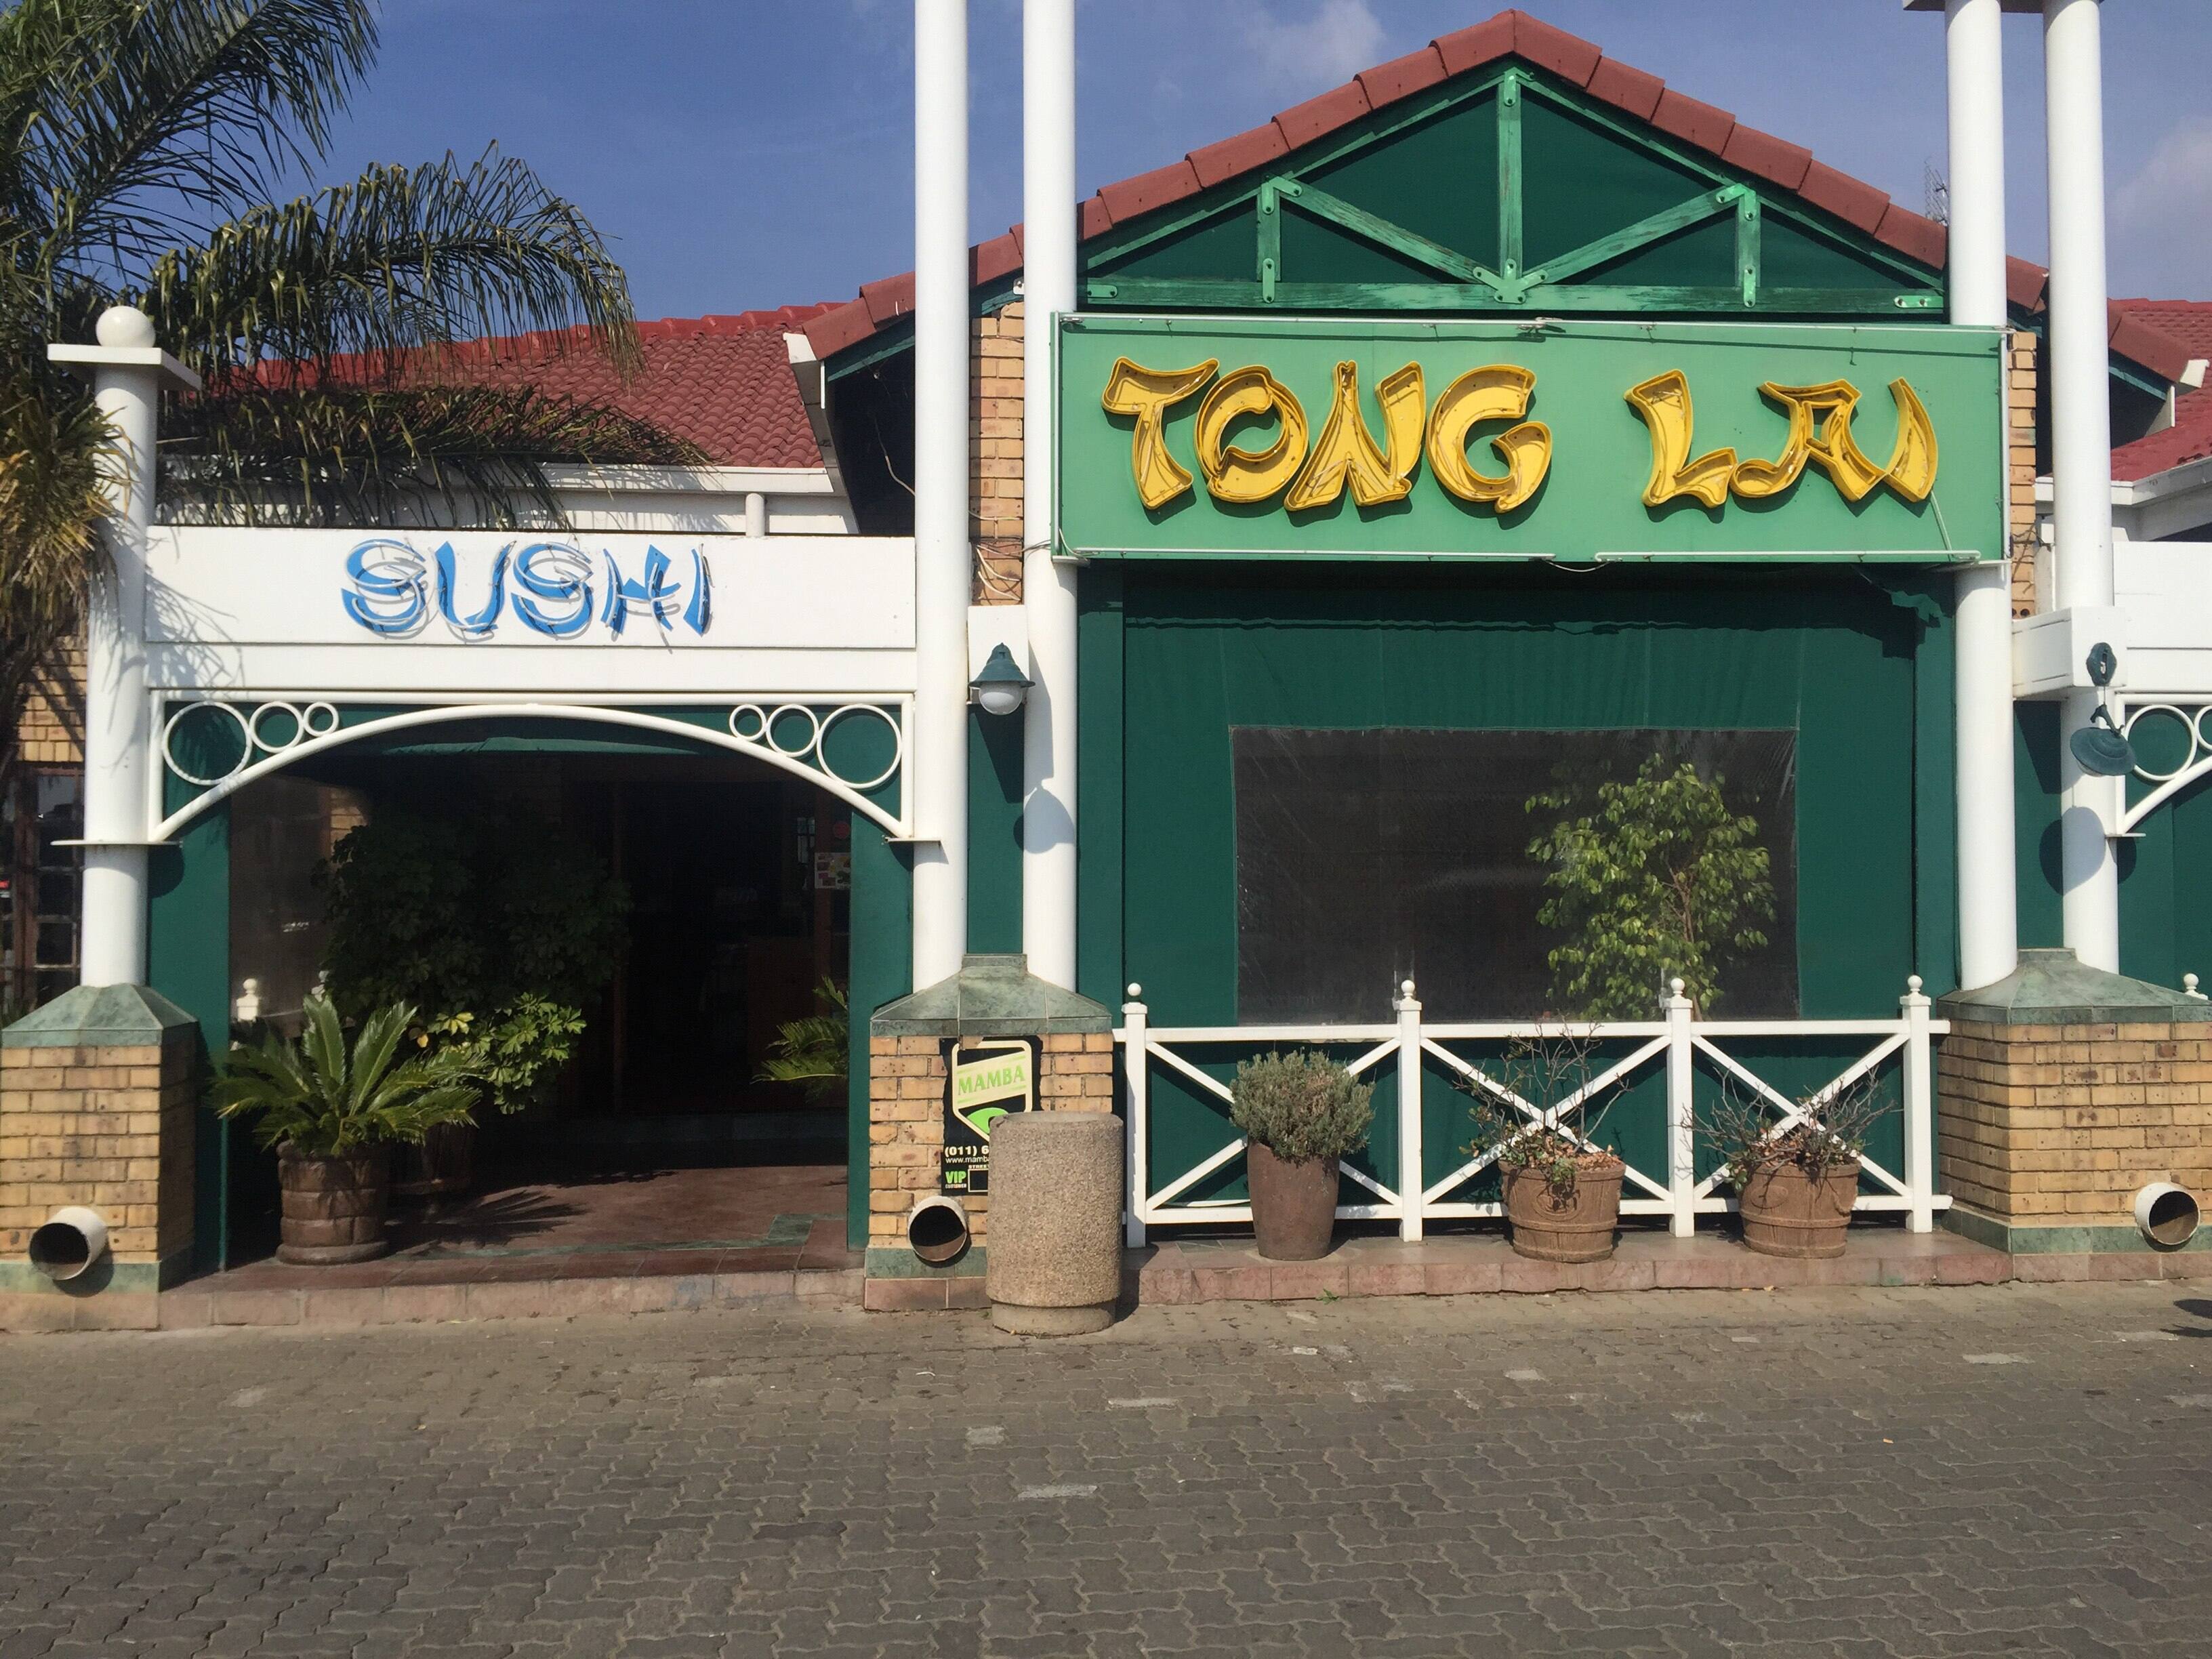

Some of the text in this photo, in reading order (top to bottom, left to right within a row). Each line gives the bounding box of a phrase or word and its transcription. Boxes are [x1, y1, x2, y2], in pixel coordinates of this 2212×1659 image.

[1101, 356, 1553, 515] TONG
[341, 538, 714, 641] SUSHI
[958, 1065, 1025, 1095] MAMBA
[944, 1145, 977, 1158] (011)
[945, 1170, 966, 1184] VIP
